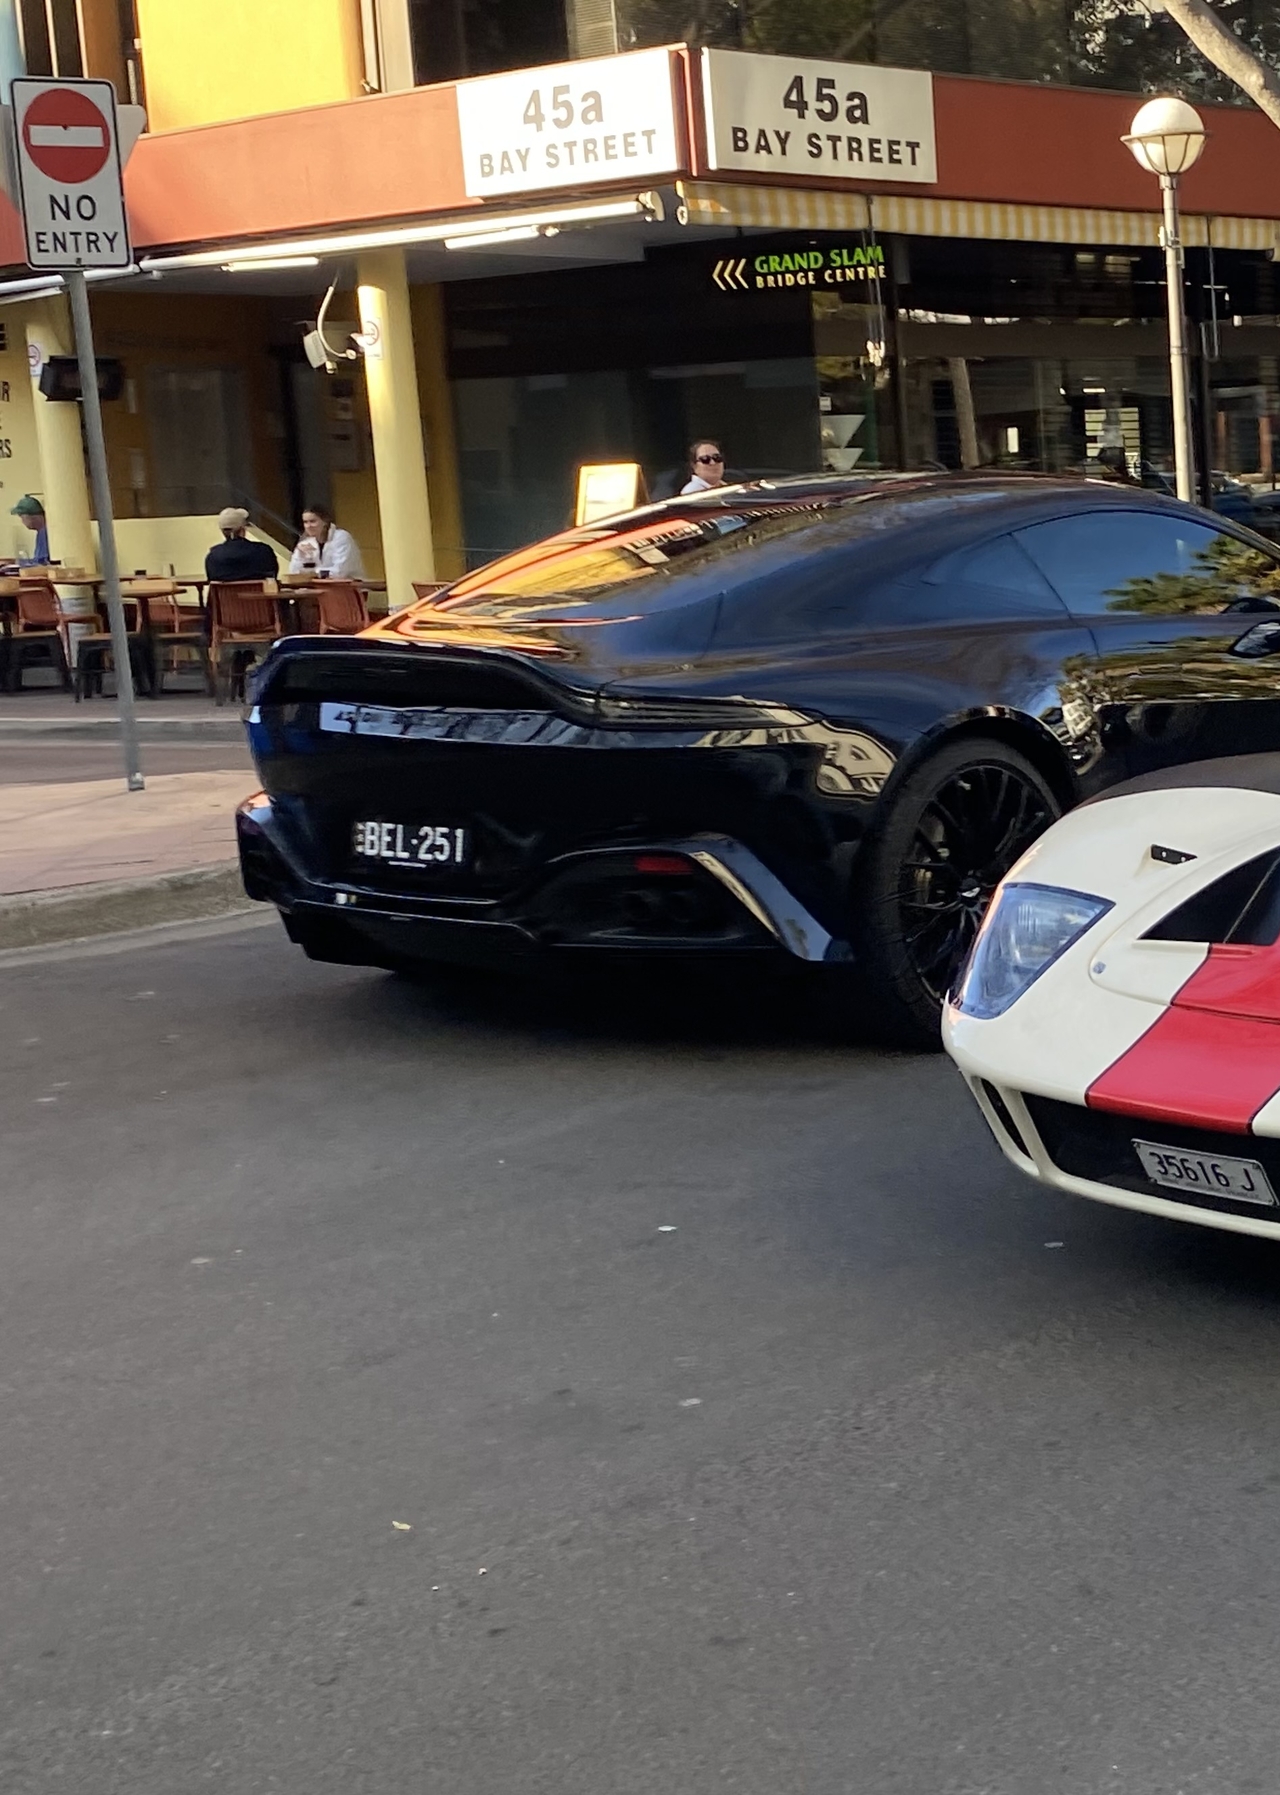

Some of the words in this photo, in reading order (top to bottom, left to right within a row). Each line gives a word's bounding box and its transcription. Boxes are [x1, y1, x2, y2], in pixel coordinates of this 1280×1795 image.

[522, 84, 604, 132] 45a
[782, 75, 870, 125] 45a
[479, 147, 531, 178] BAY
[545, 128, 657, 169] STREET
[731, 126, 791, 156] BAY
[806, 132, 921, 166] STREET
[49, 193, 97, 221] NO
[35, 231, 118, 253] ENTRY
[754, 251, 824, 273] GRAND
[829, 245, 885, 267] SLAM
[755, 271, 816, 288] BRIDGE
[824, 265, 887, 283] CENTRE
[1149, 1151, 1230, 1188] 35616
[1242, 1168, 1255, 1192] J
